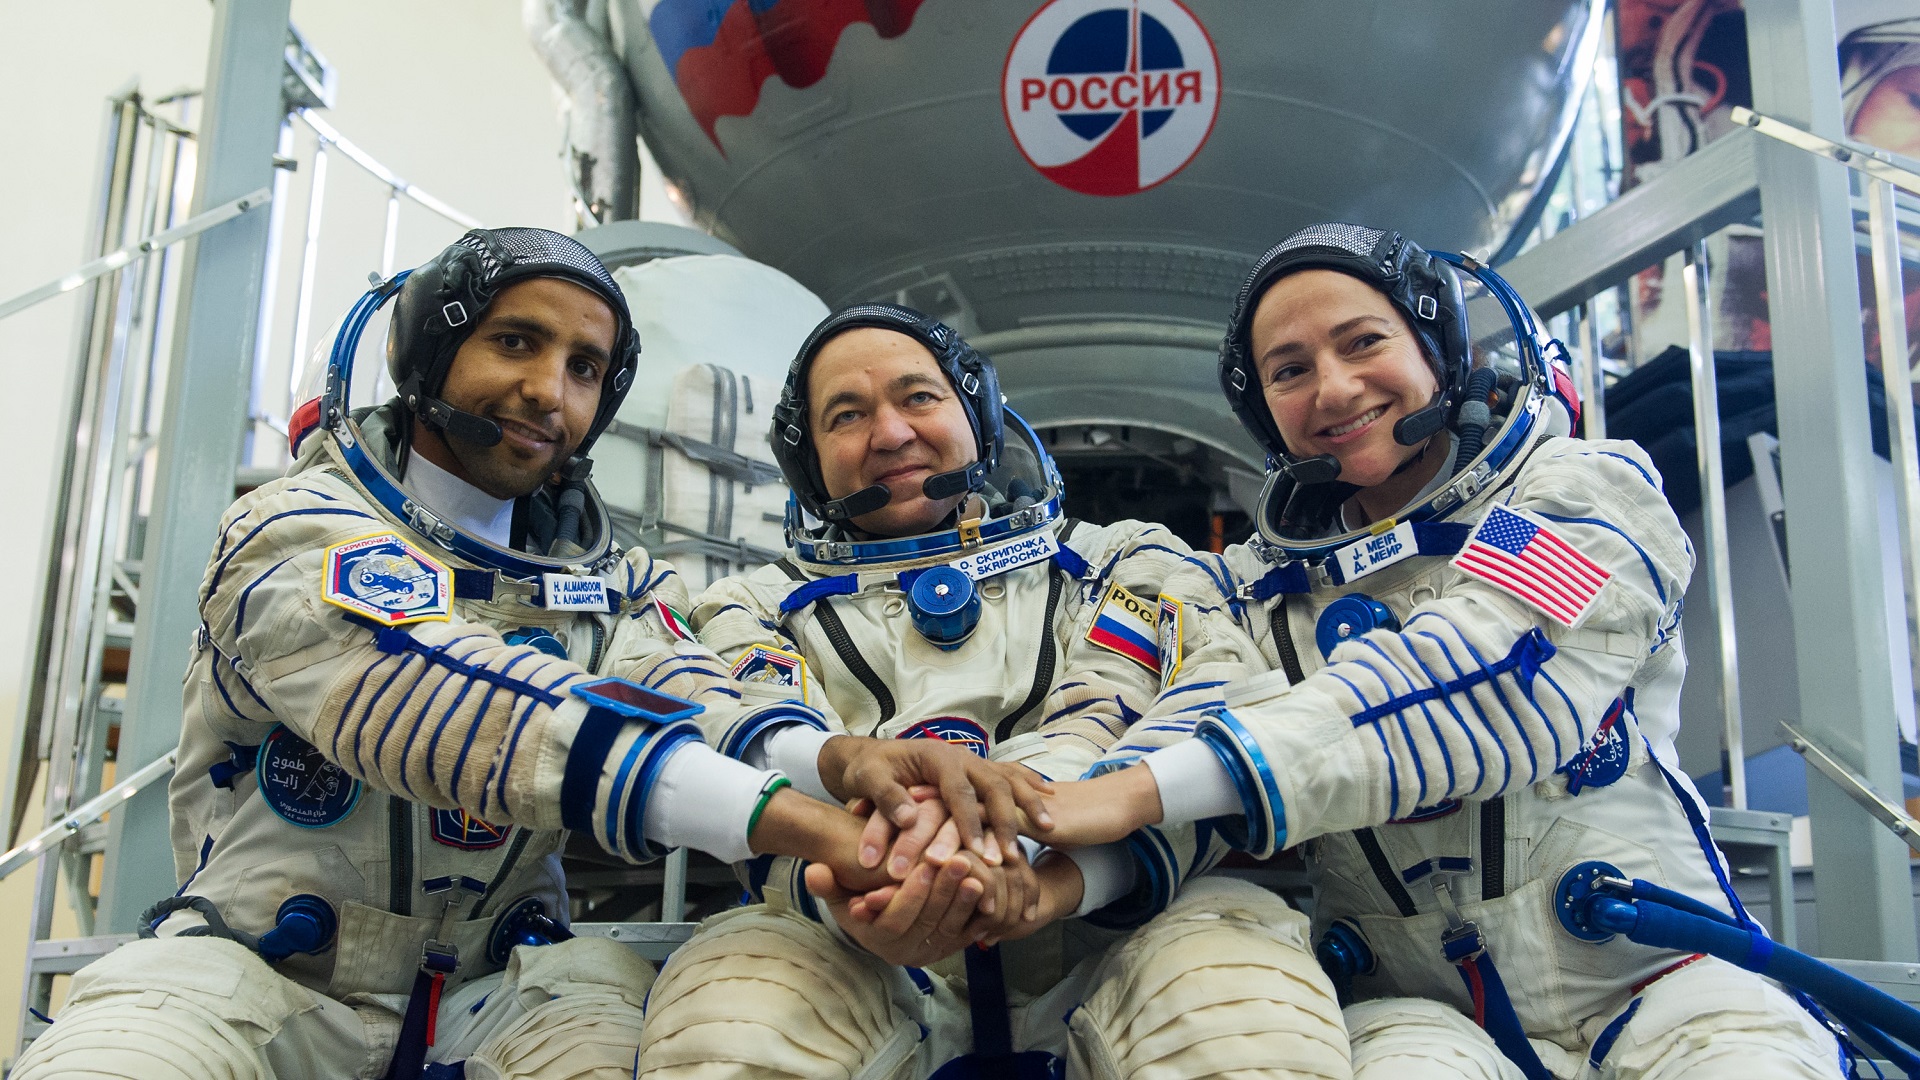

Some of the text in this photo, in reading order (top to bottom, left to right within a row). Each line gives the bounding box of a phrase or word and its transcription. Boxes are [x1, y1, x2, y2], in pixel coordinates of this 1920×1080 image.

[1021, 70, 1202, 112] РОССИЯ
[338, 537, 390, 553] СКРИПОЧКА
[960, 536, 1047, 570] О. СКРИПОЧКА
[1353, 532, 1396, 560] J. MEIR
[976, 545, 1051, 575] SKRIPOCHKA
[1354, 561, 1367, 575] Д.
[554, 581, 601, 592] H. ALMANSOORI
[383, 597, 403, 606] МС
[553, 594, 605, 605] Х. АЛЬМАНСУРИ
[1111, 589, 1156, 627] РОС
[272, 756, 305, 771] طموح
[272, 773, 299, 790] زايد
[297, 815, 319, 823] mission
